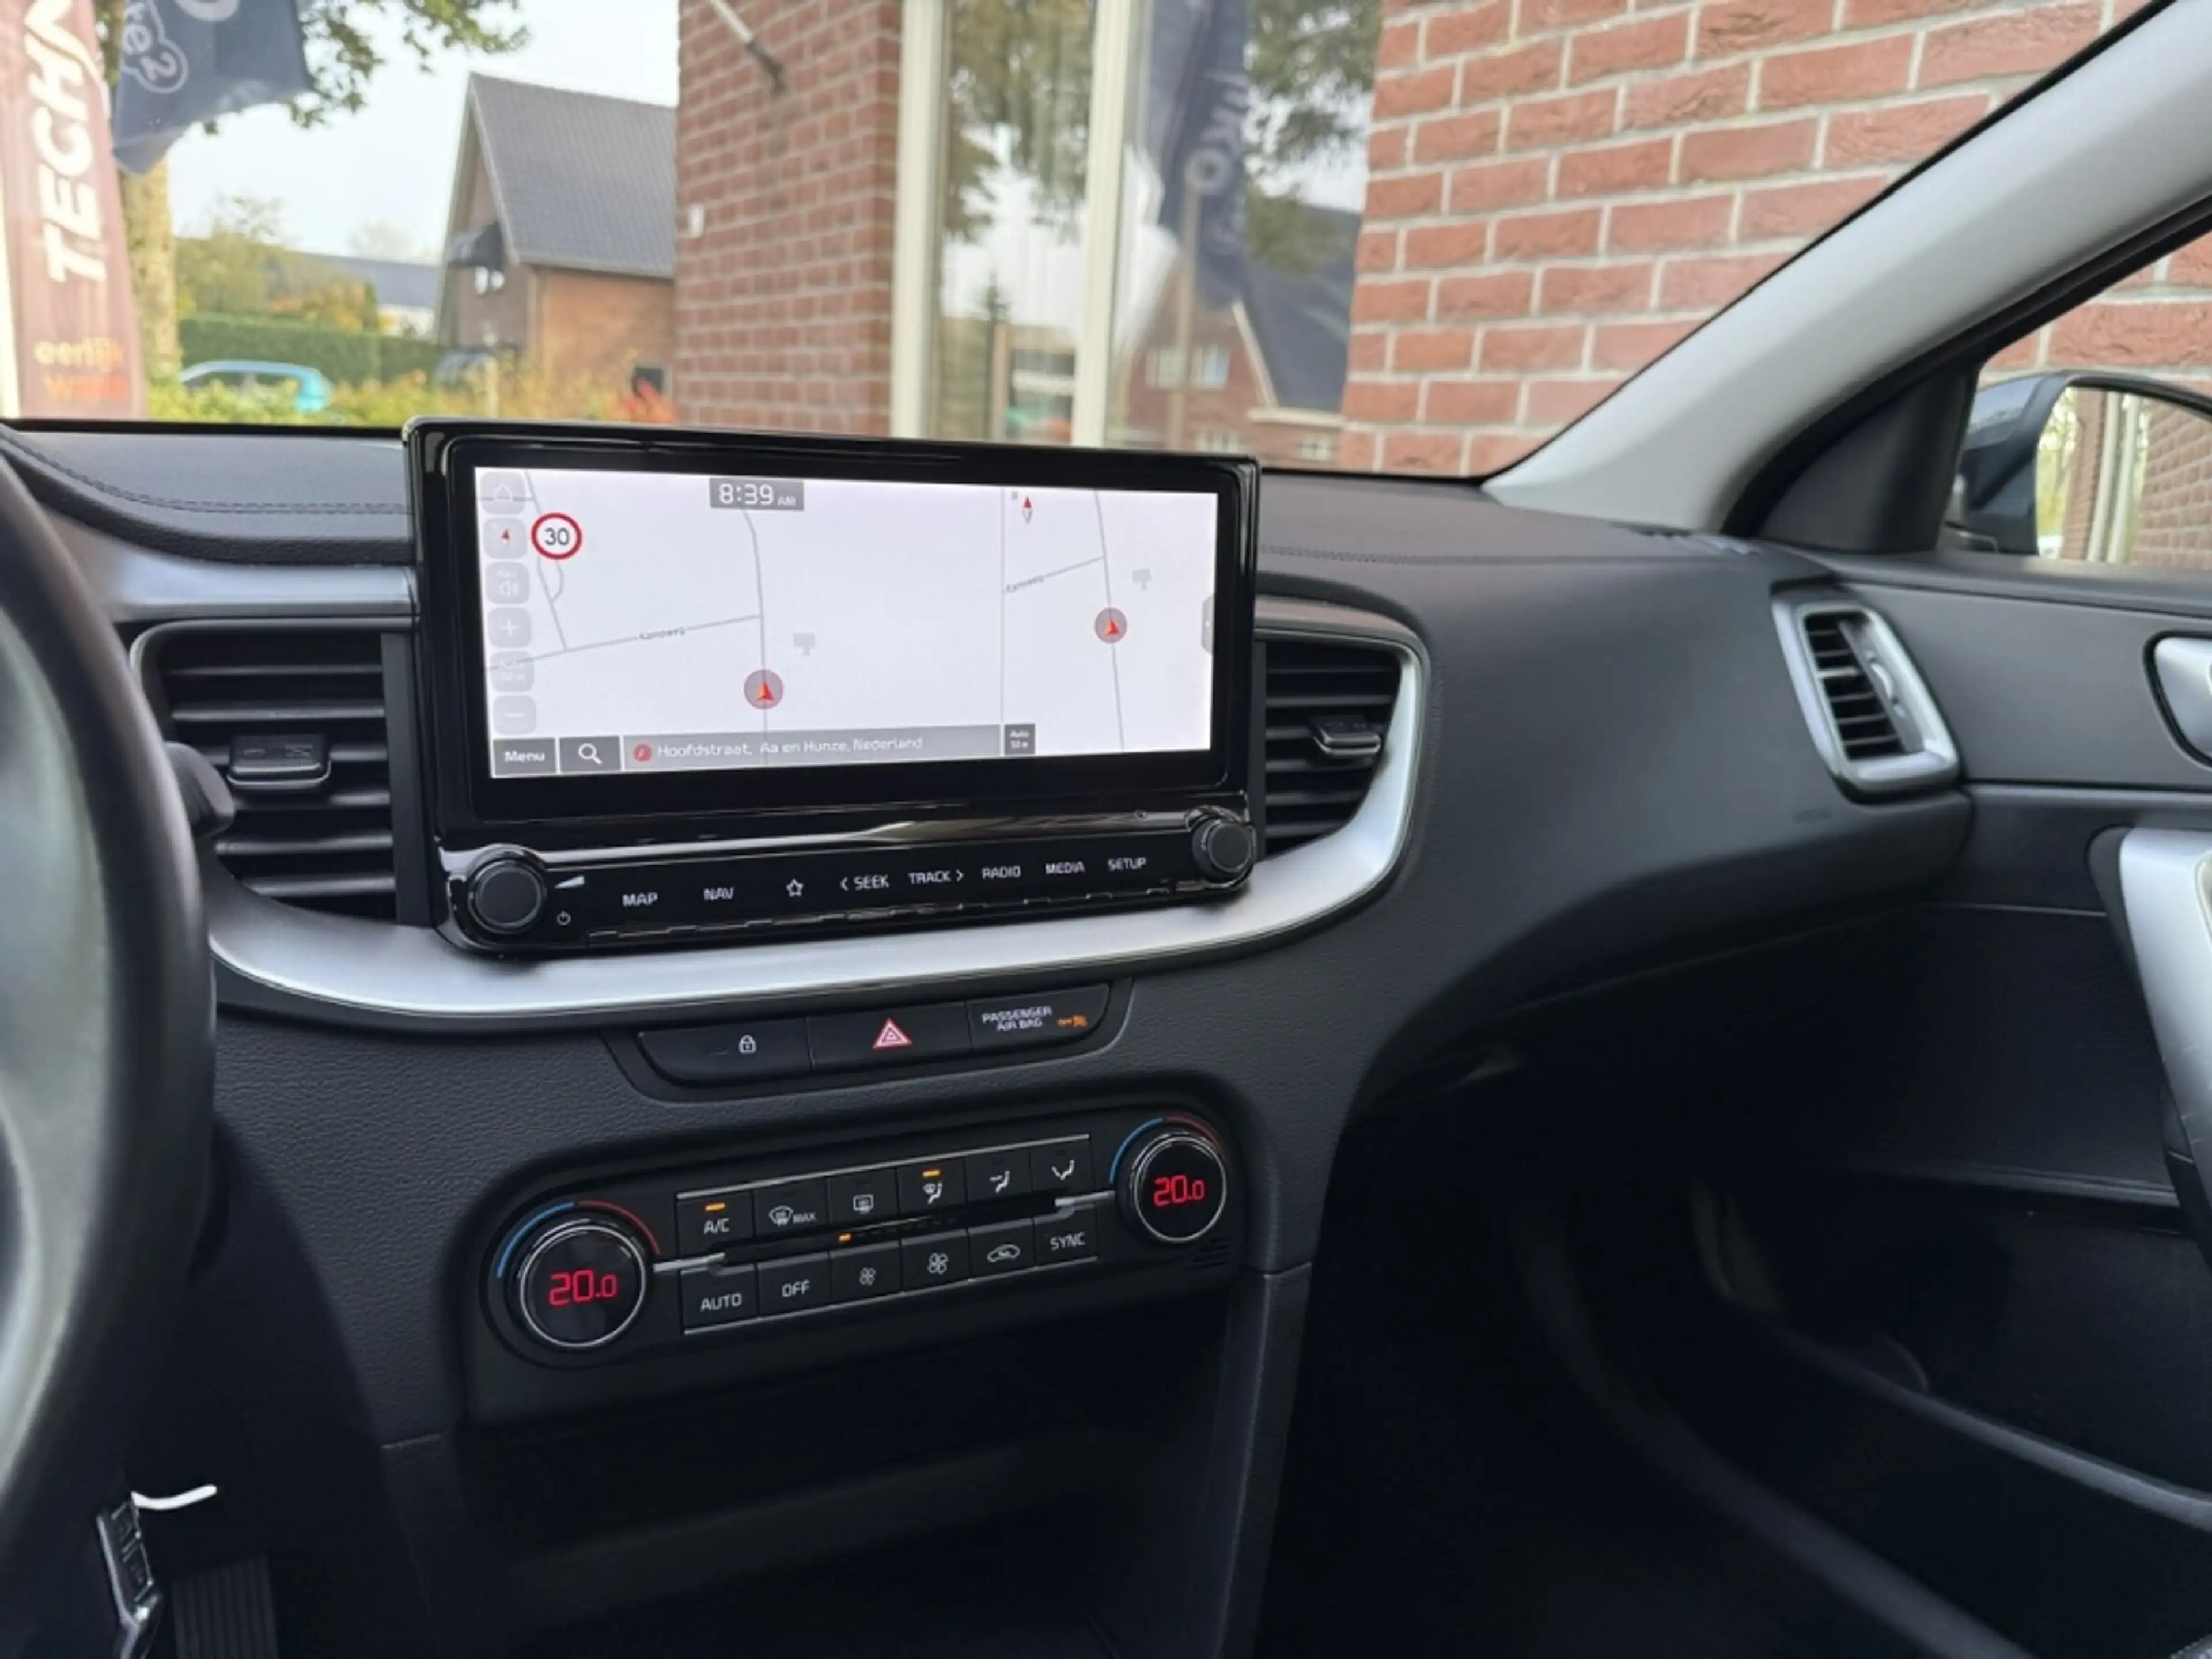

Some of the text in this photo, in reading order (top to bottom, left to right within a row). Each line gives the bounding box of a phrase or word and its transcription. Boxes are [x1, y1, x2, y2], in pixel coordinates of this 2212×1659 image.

[719, 483, 797, 507] 8:39 AM
[544, 527, 570, 546] 30
[760, 742, 779, 754] Aa
[782, 743, 802, 753] en
[853, 737, 923, 751] Nederland
[503, 751, 546, 763] Menu
[622, 857, 1147, 907] MAP NAV SEEK TRACK RADIO MEDIA SETUP
[982, 1005, 1053, 1024] PASSENGER
[997, 1017, 1043, 1032] AIR BAG
[1153, 1175, 1205, 1207] 20.0
[703, 1218, 730, 1234] A/C
[793, 1212, 817, 1224] MAX
[1050, 1231, 1086, 1251] SYNC
[549, 1270, 618, 1306] 20.0
[781, 1279, 810, 1298] OFF
[700, 1292, 743, 1312] AUTO
